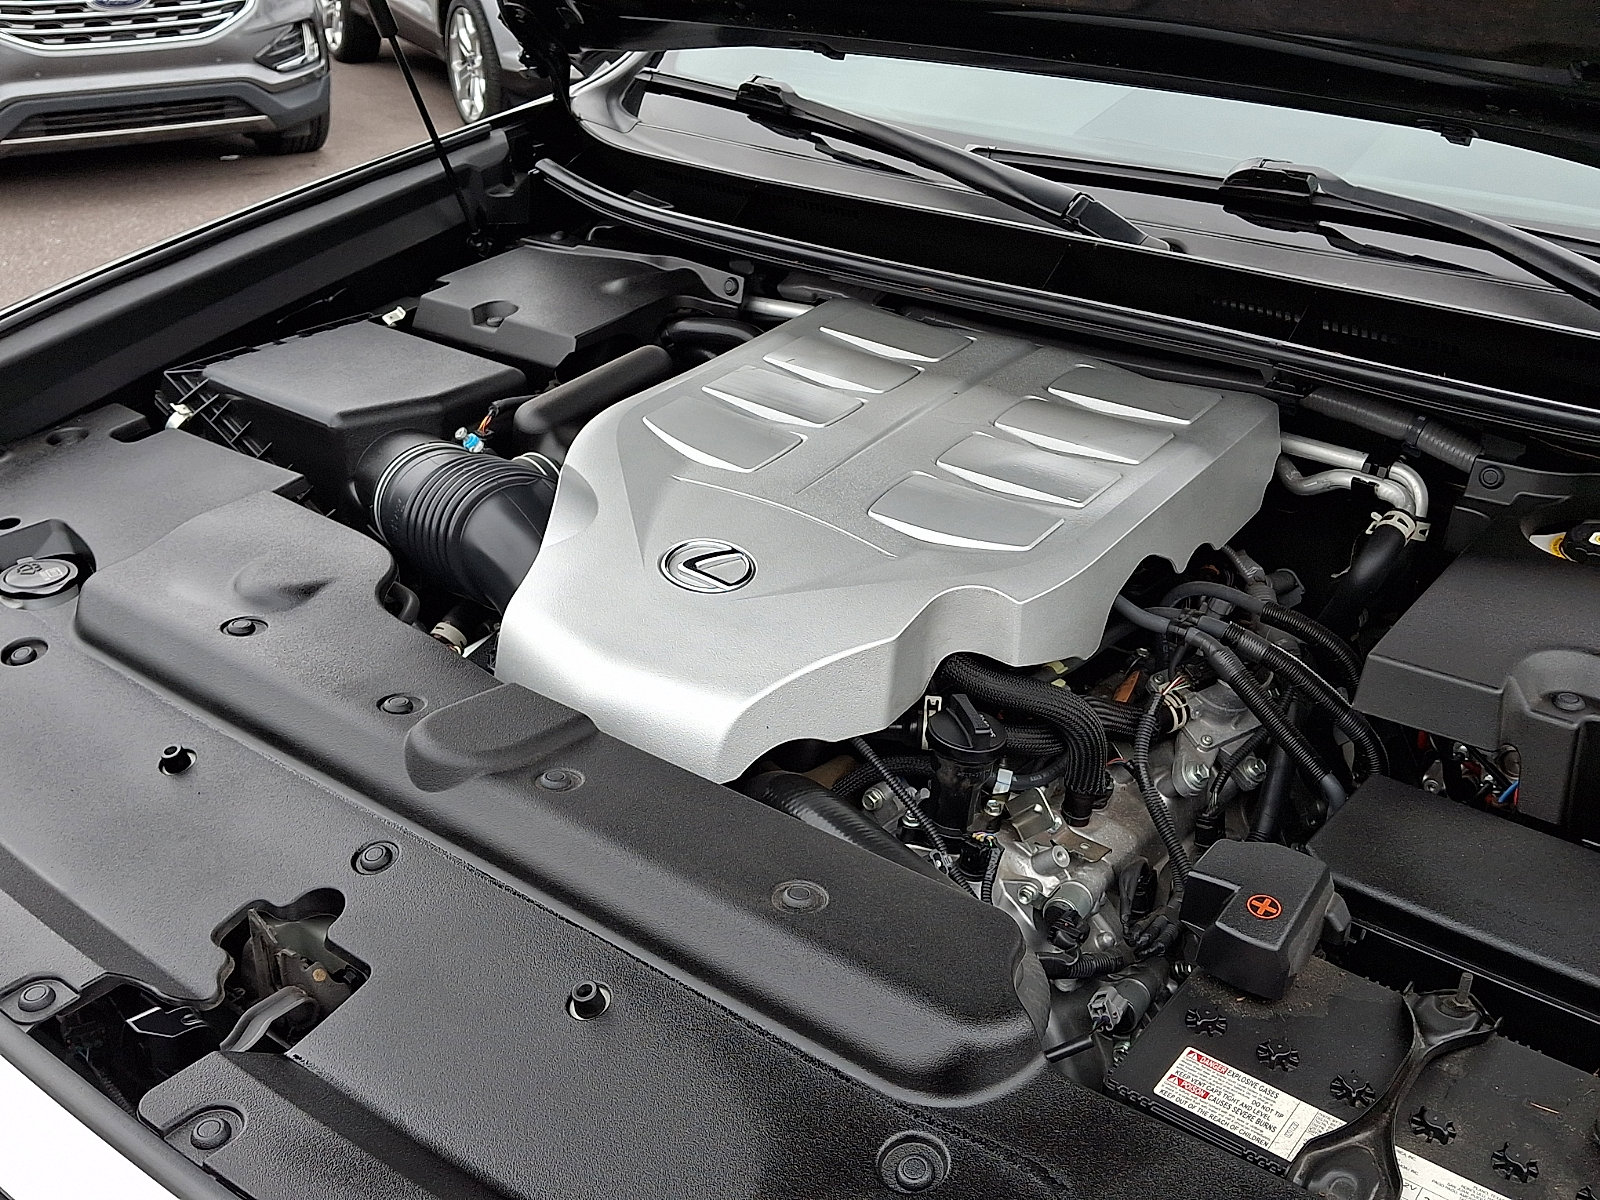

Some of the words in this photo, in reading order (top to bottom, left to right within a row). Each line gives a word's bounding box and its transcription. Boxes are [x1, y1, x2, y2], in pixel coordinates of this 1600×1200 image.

[1175, 1070, 1191, 1080] KEEP
[1191, 1077, 1207, 1088] VENT
[1206, 1085, 1222, 1096] CAPS
[1223, 1093, 1240, 1104] TIGHT
[1240, 1102, 1252, 1111] AND
[1252, 1107, 1271, 1121] LEVEL
[1200, 1056, 1227, 1074] DANGER
[1227, 1070, 1259, 1089] EXPLOSIVE
[1259, 1085, 1279, 1099] GASES
[1159, 1089, 1175, 1099] KEEP
[1175, 1097, 1188, 1106] OUT
[1198, 1107, 1209, 1116] THE
[1209, 1113, 1229, 1127] REACH
[1239, 1128, 1269, 1147] CHILDREN
[1180, 1080, 1206, 1098] POISON
[1208, 1095, 1232, 1110] CAUSES
[1232, 1106, 1256, 1122] SEVERE
[1255, 1117, 1277, 1133] BURNS
[1261, 1104, 1274, 1114] NOT
